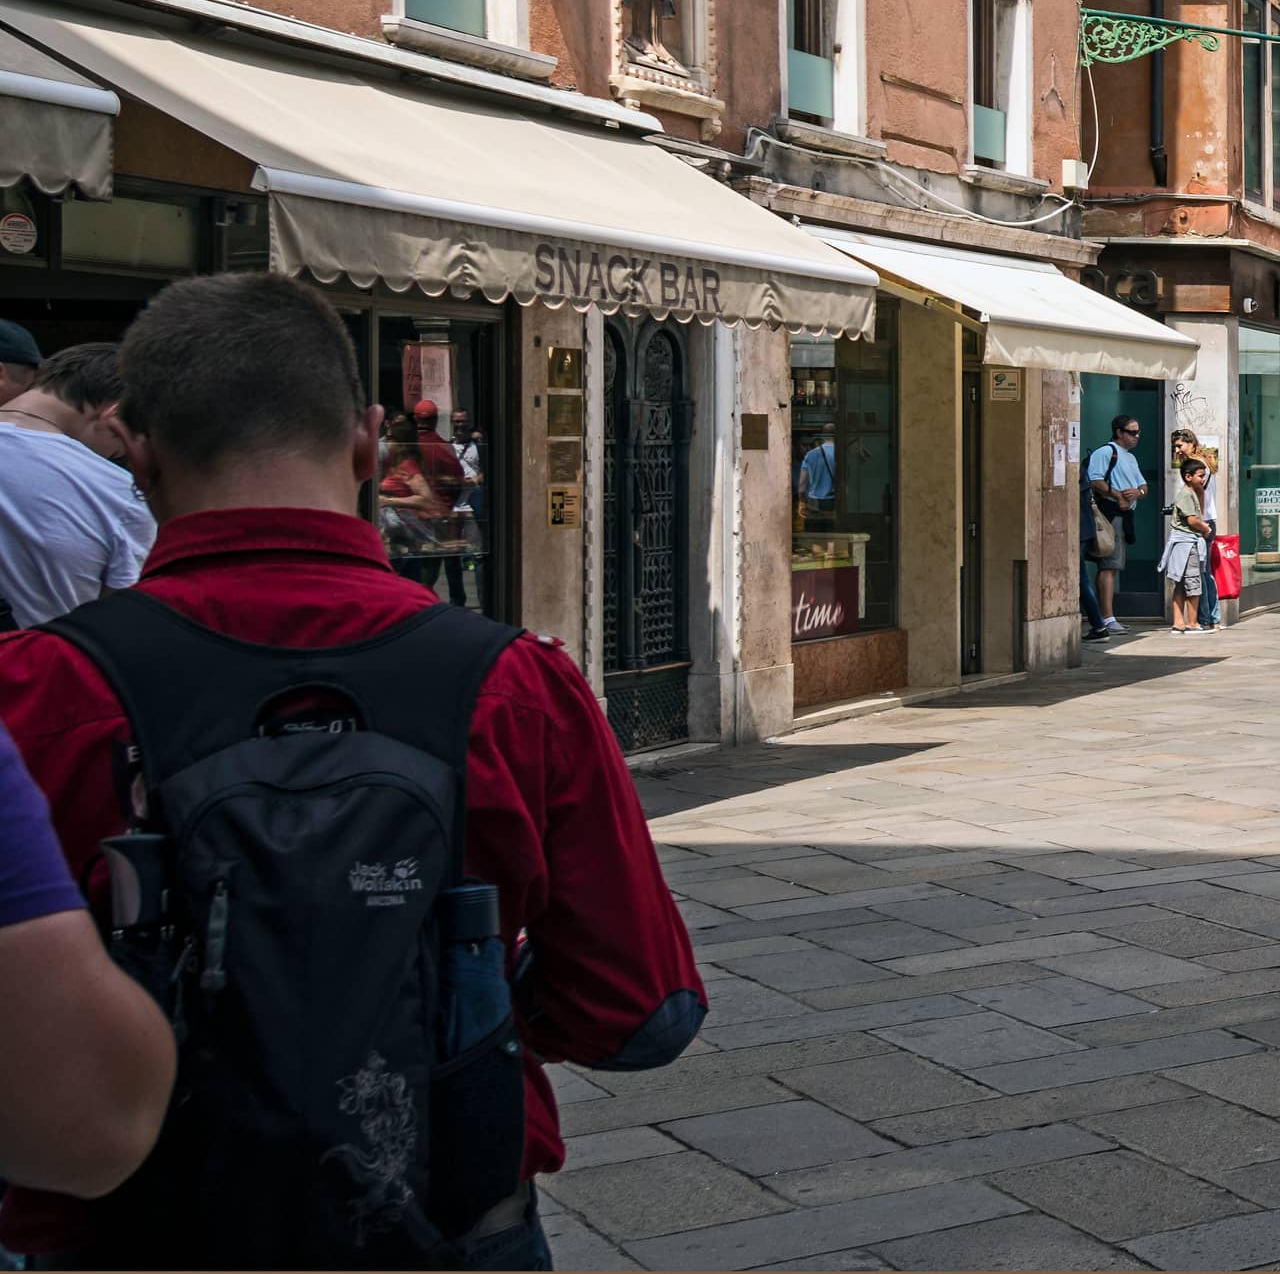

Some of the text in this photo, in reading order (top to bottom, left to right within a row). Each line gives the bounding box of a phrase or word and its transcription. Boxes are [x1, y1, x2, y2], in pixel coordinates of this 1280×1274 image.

[535, 243, 724, 314] SNACK BAR
[349, 860, 387, 876] Jack
[348, 875, 423, 892] Wolfskin
